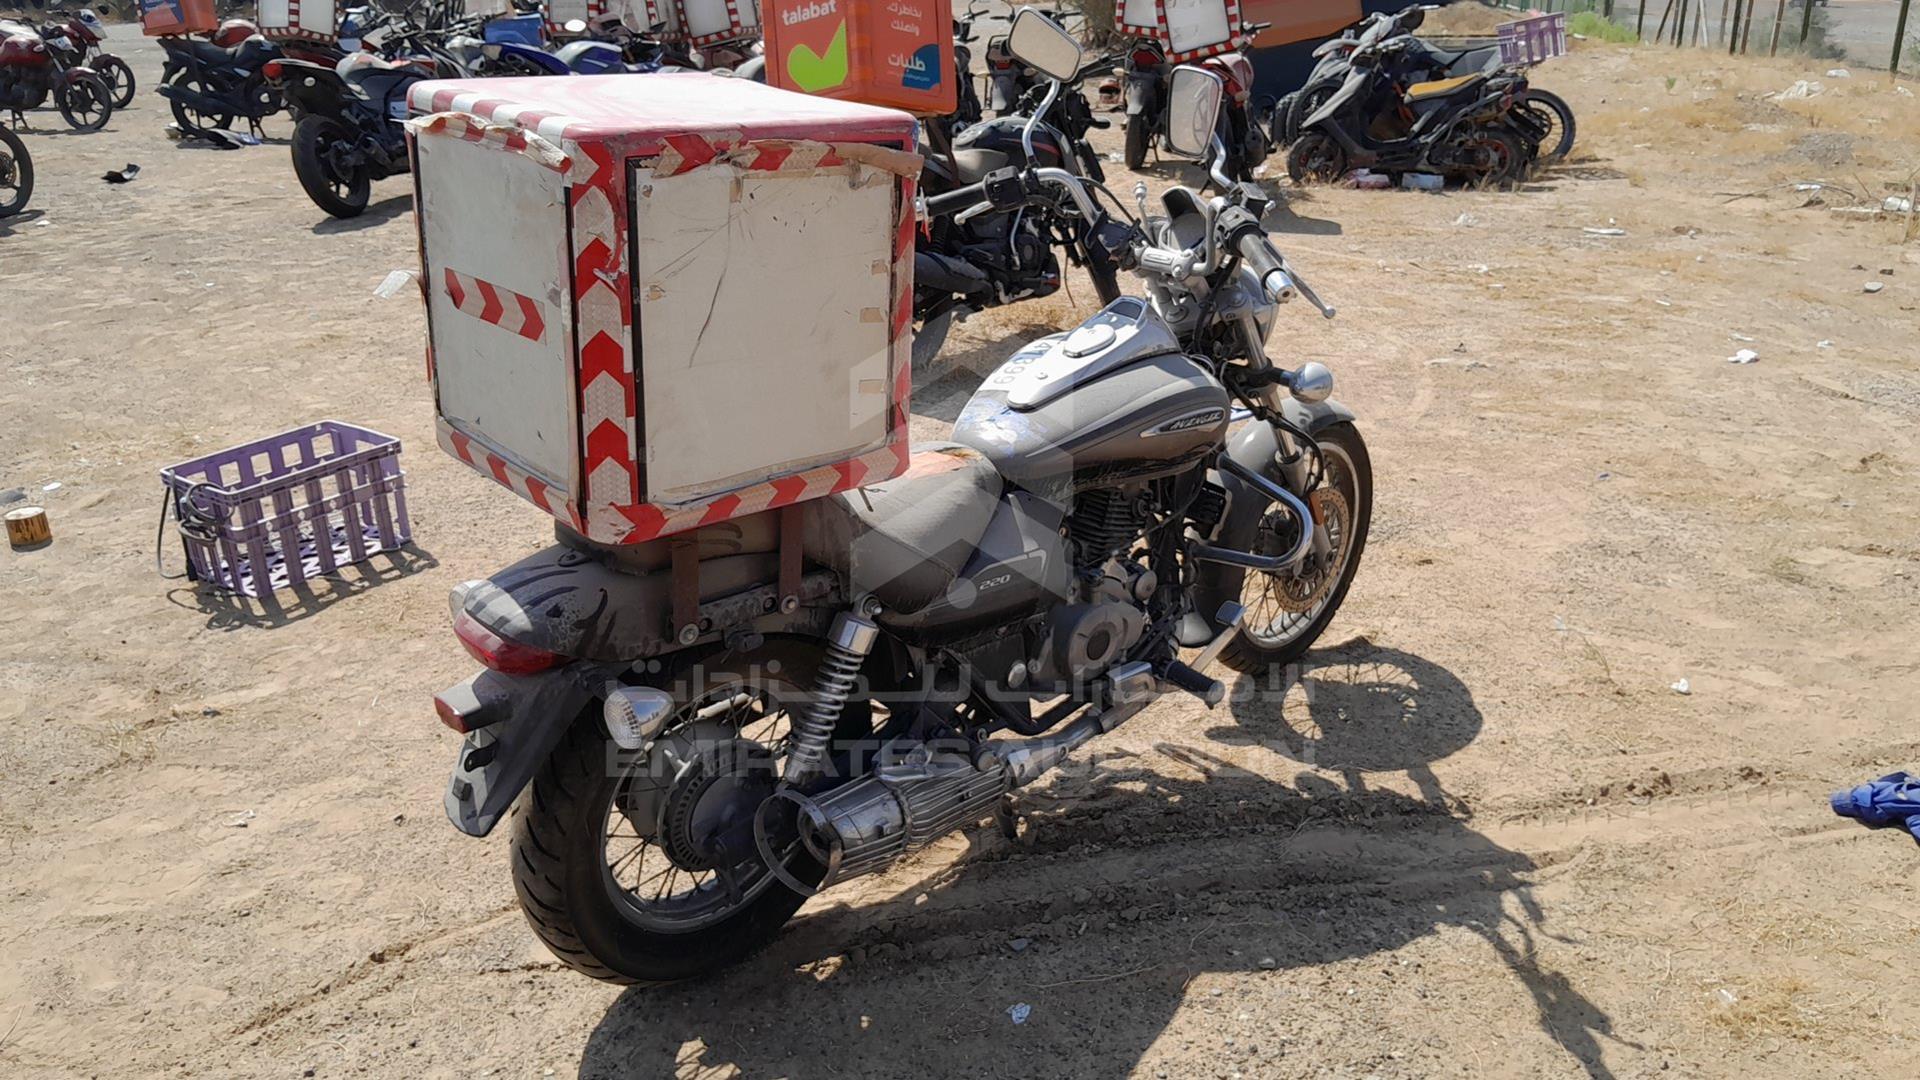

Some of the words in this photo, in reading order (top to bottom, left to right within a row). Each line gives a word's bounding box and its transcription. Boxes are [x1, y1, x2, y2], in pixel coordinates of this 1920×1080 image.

[782, 0, 837, 26] talabat
[888, 52, 926, 73] طلبات
[978, 574, 1012, 591] 220
